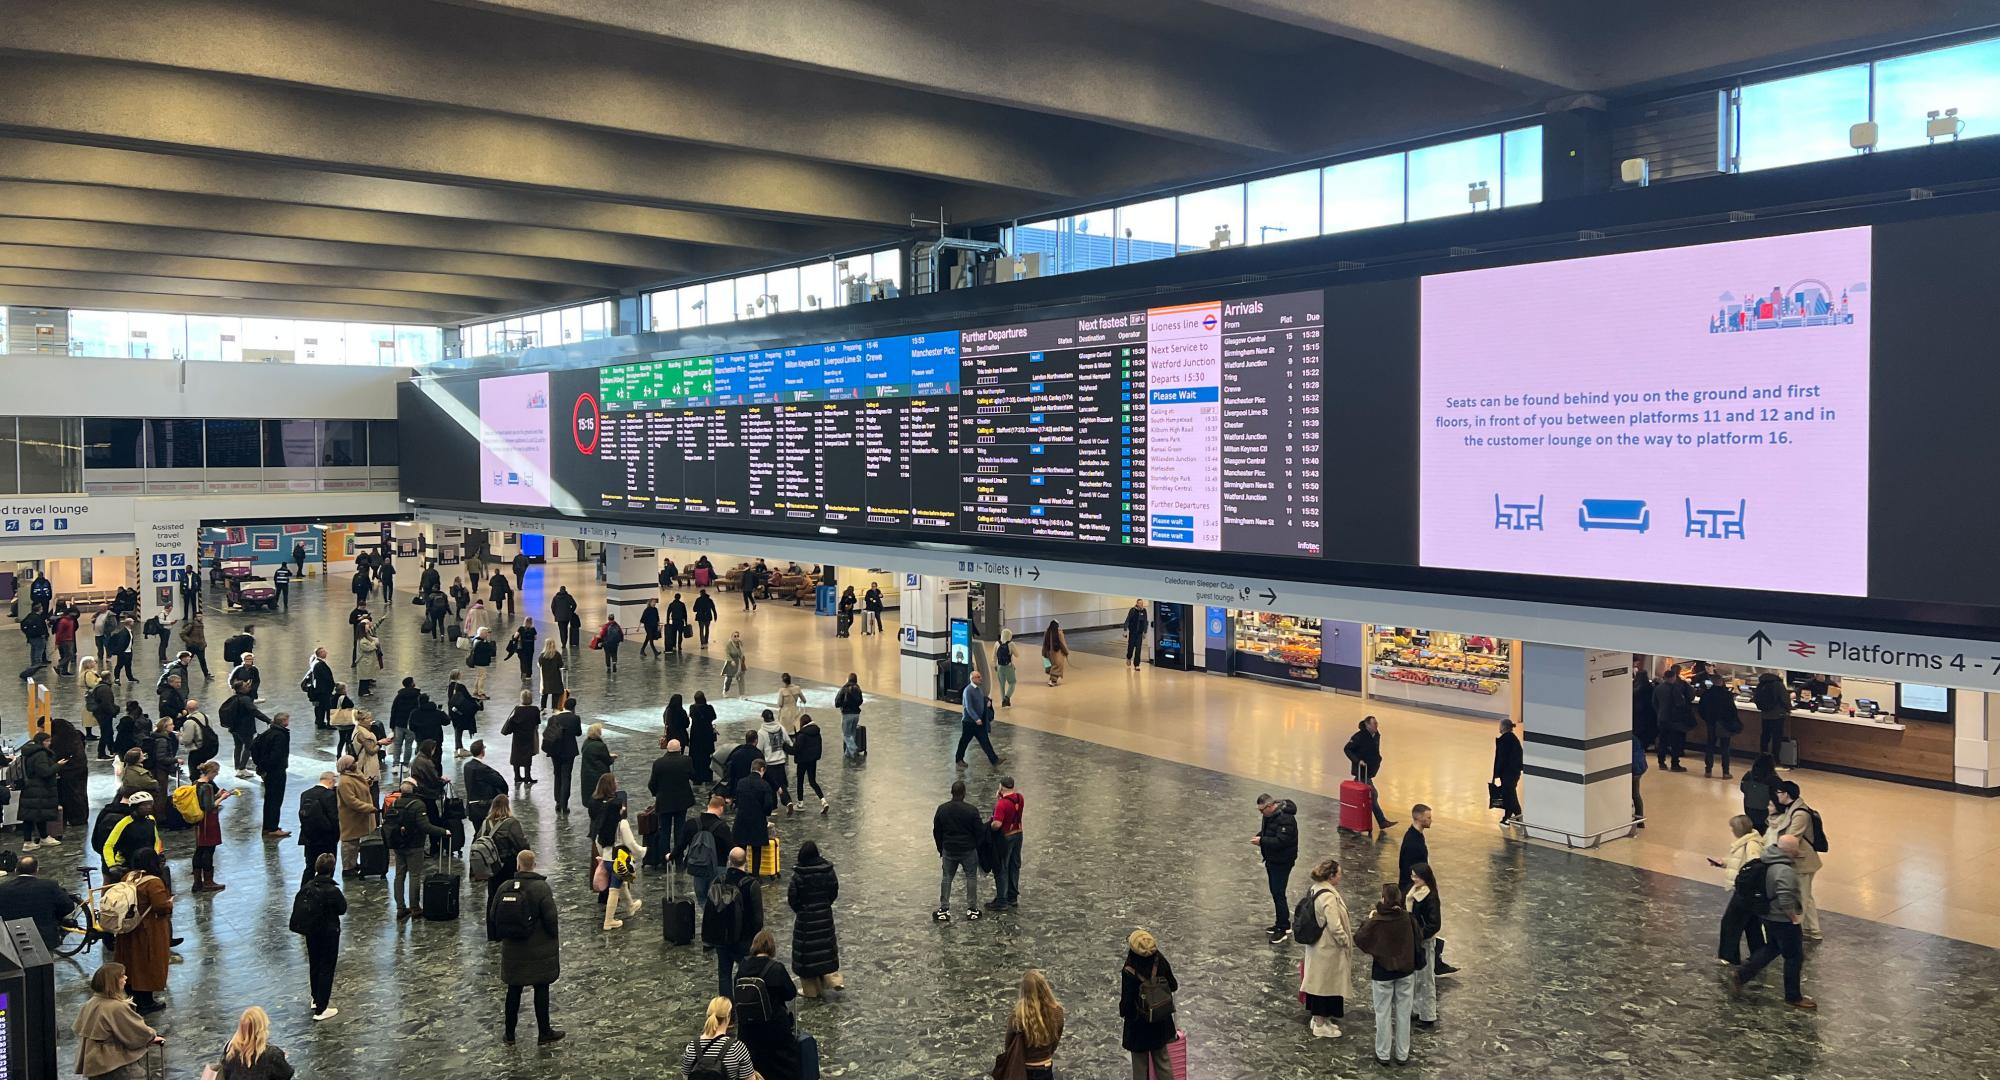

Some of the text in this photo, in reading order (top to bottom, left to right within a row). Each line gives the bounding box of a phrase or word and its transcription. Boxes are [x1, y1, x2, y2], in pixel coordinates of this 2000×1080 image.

[1224, 300, 1263, 316] Arrivals
[1079, 319, 1098, 331] Next
[1099, 316, 1128, 329] fastest
[1306, 313, 1320, 322] Due
[1151, 320, 1198, 332] Lioness line
[962, 328, 1028, 343] Further Departures
[912, 346, 956, 358] Manchester Picc
[1151, 346, 1169, 354] Next
[1171, 344, 1198, 352] Service
[1224, 349, 1255, 357] Birmingham
[824, 357, 844, 366] Liverpool
[1151, 358, 1216, 369] Watford Junction
[1151, 372, 1205, 384] Departs 15:30
[1153, 390, 1197, 400] Please Wait
[1446, 384, 1820, 408] Seats can be found behind you on the ground and first
[1436, 407, 1836, 428] floors, in front of you between platforms 11 and 12 and in
[578, 418, 594, 430] 15:15
[1464, 431, 1793, 448] the customer lounge on the way to platform 16.
[1224, 458, 1246, 466] Glasgow
[12, 505, 46, 515] travel
[50, 505, 89, 515] lounge
[1224, 505, 1237, 513] Tring
[1224, 517, 1254, 525] Birmingham
[1298, 542, 1320, 550] infotec
[984, 562, 1010, 575] Toilets
[1164, 577, 1235, 590] Caledonian Sleeper Club
[1196, 592, 1234, 603] guest lounge
[1828, 640, 1943, 670] Platforms
[1950, 653, 1966, 672] 4
